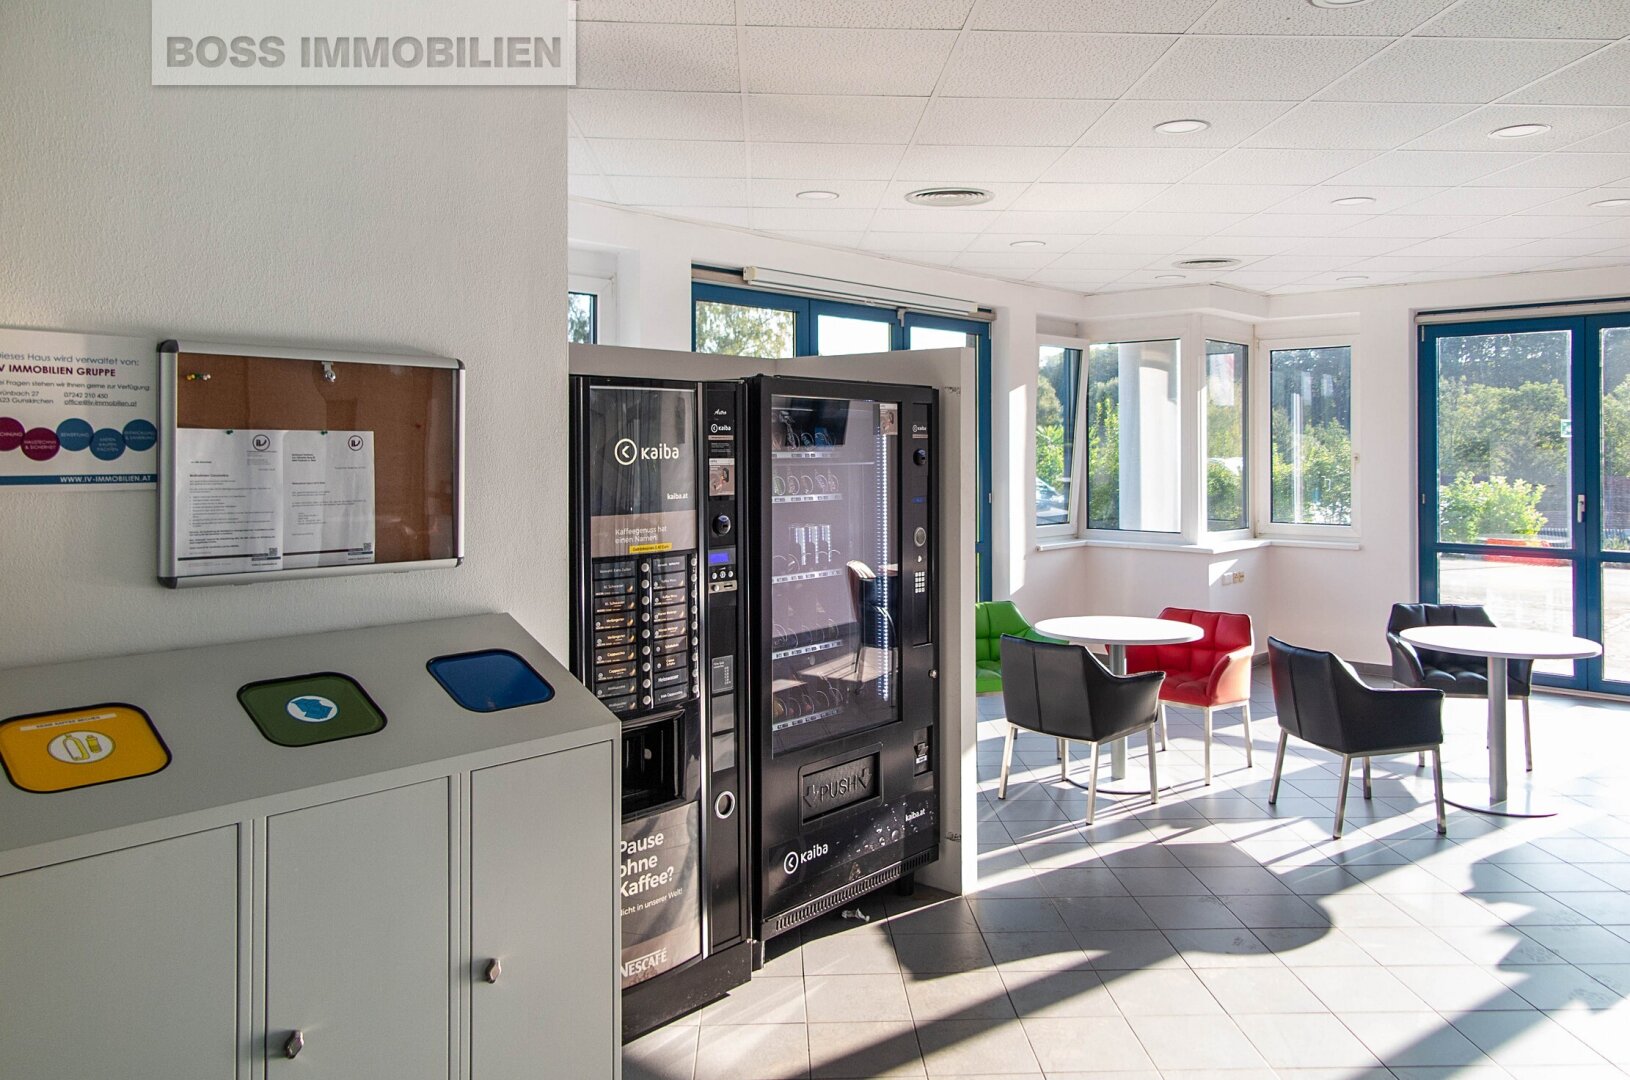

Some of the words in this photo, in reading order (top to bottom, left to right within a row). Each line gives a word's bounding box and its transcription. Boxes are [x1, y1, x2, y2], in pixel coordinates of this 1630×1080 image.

[27, 353, 51, 361] Haus
[76, 357, 118, 366] verwaltet
[9, 364, 73, 375] IMMOBILIEN
[76, 367, 116, 377] GRUPPE
[60, 474, 151, 483] WWW.IV-IMMOBILIEN.AT
[667, 492, 689, 500] kaiba.at
[615, 527, 656, 536] Kaffeegenuss
[634, 533, 657, 543] Namen
[819, 777, 857, 803] PUSH
[904, 808, 926, 822] kaiba.at
[800, 843, 830, 864] kaiba
[620, 855, 659, 878] ohne
[620, 865, 675, 898] Kaffee?
[620, 905, 636, 917] icht
[637, 903, 644, 911] in
[644, 894, 668, 909] unserer
